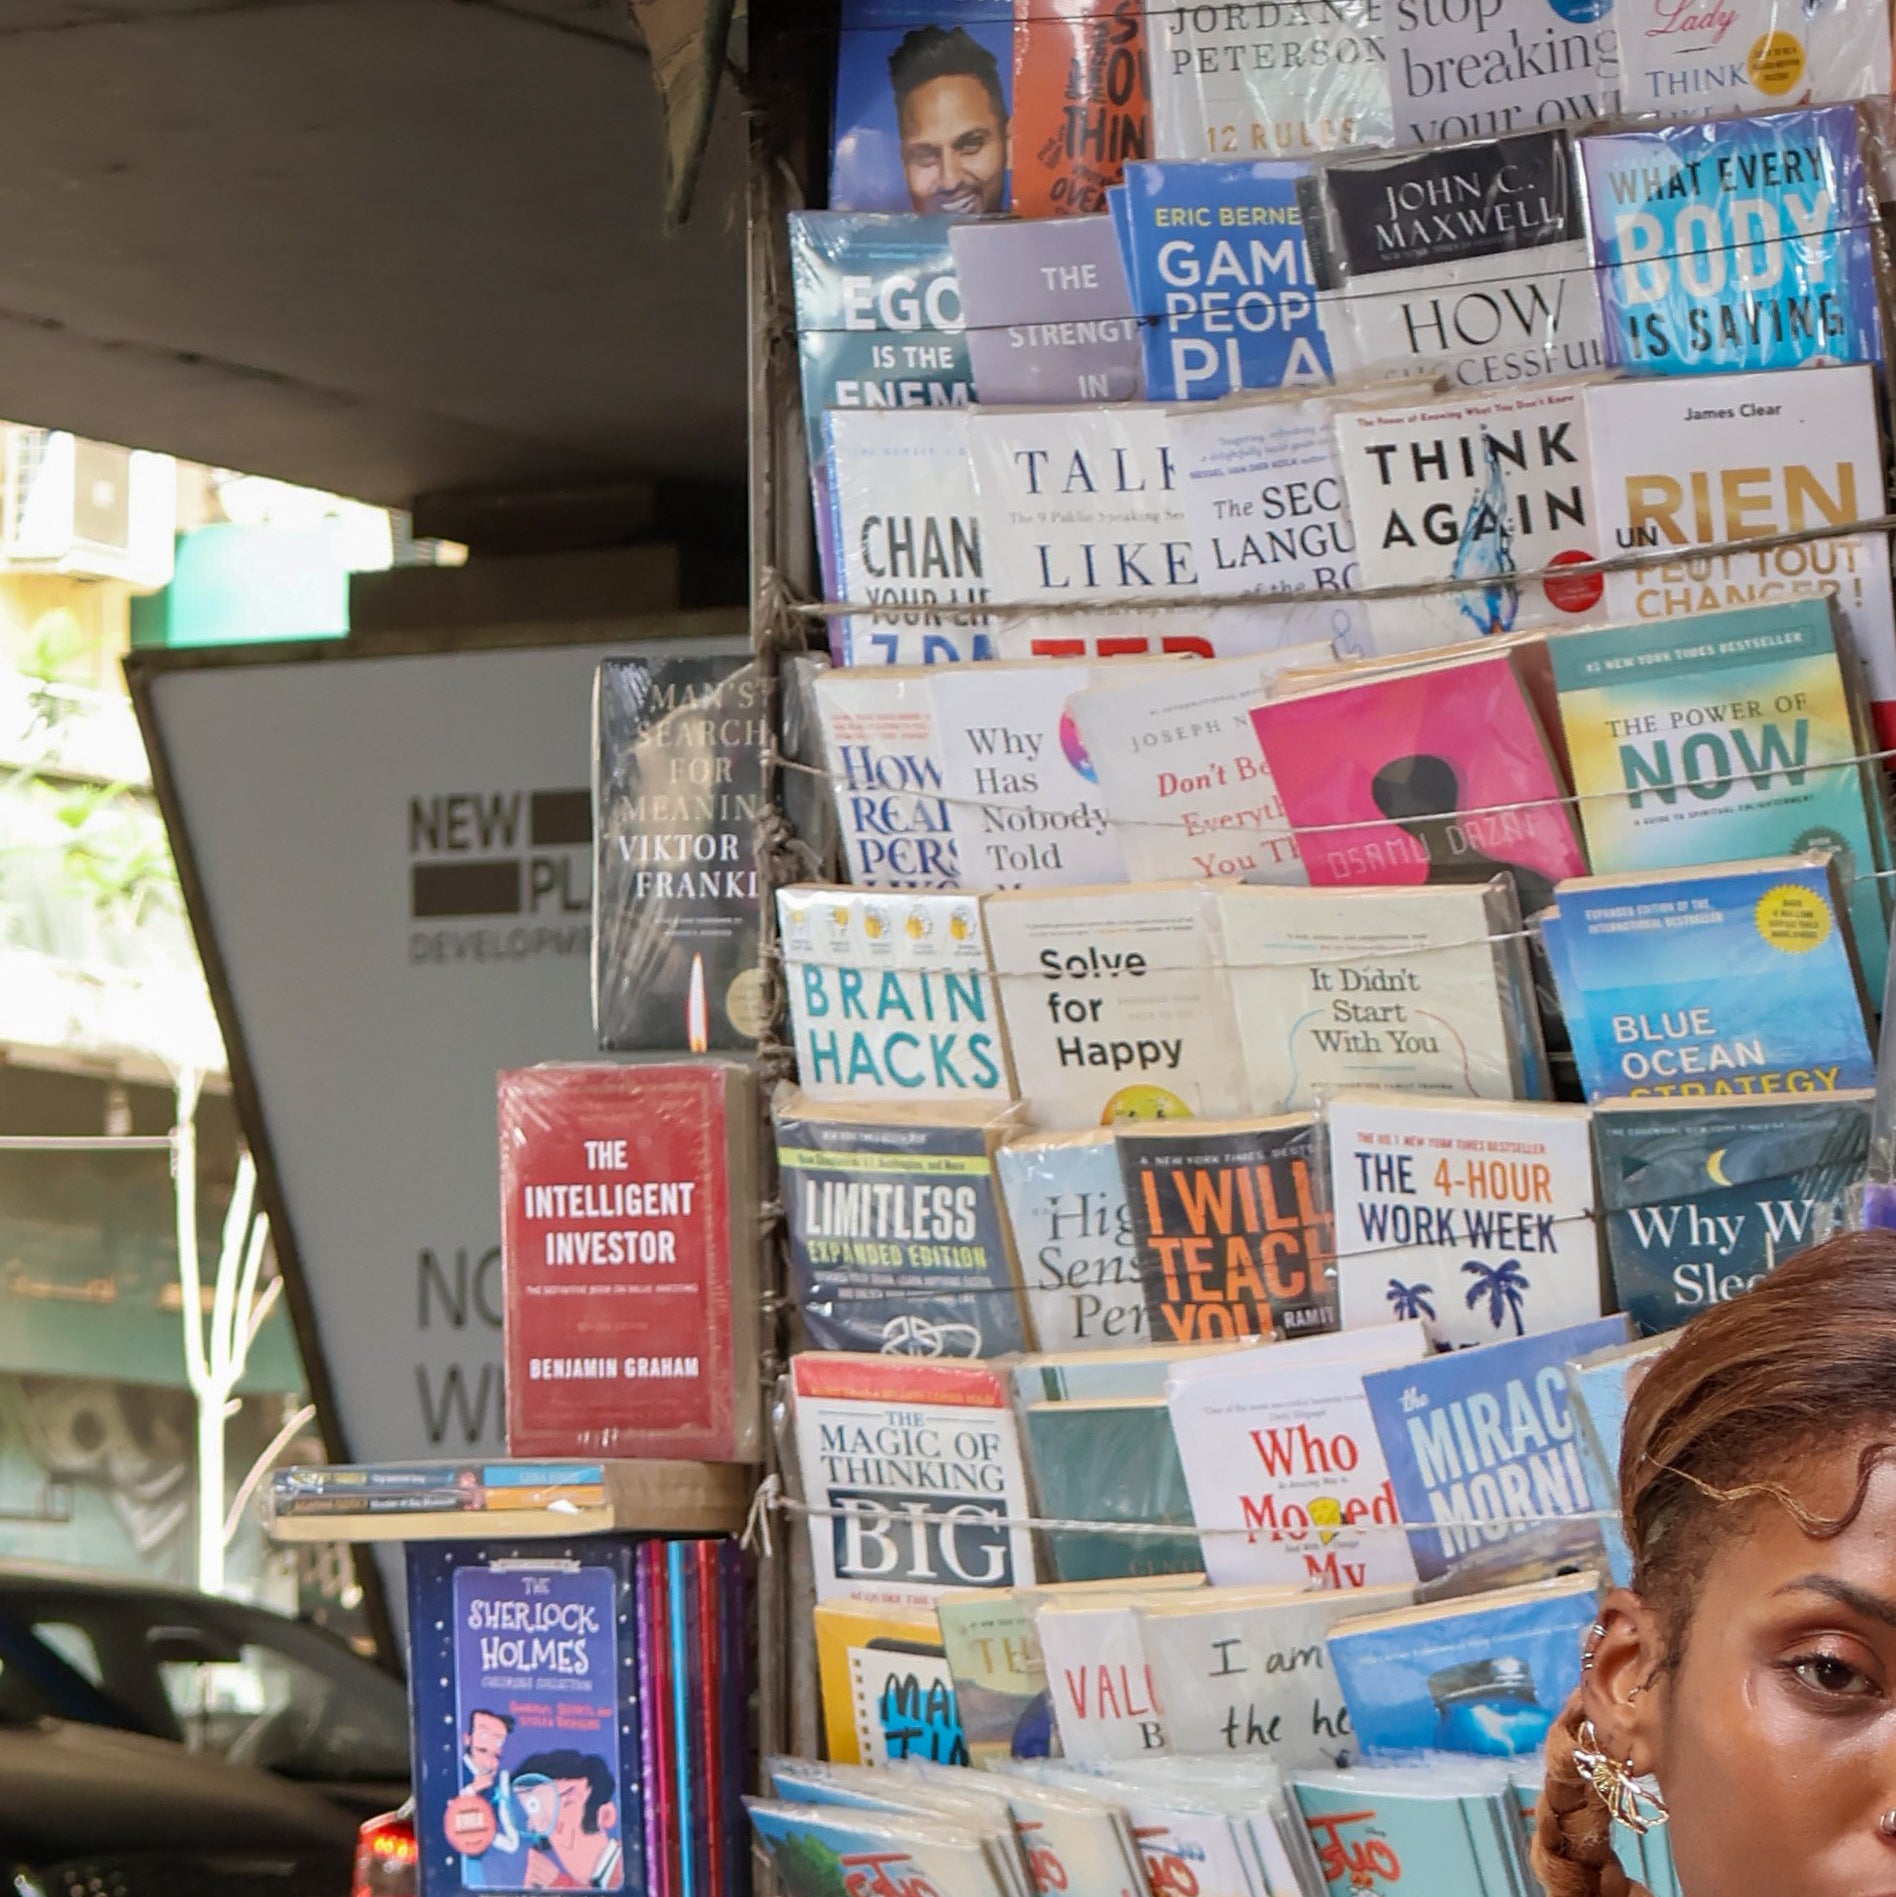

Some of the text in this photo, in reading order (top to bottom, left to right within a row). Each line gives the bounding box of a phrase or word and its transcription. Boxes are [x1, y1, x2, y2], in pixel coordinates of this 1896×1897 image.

[1171, 36, 1386, 75] PETERSON
[1403, 26, 1618, 98] breaking
[1645, 62, 1749, 98] THINK
[1206, 125, 1238, 154] 12
[1386, 165, 1536, 219] JOHN C.
[1609, 145, 1827, 206] WHAT EVERY
[1155, 206, 1302, 227] ERIC BERNE
[1374, 194, 1566, 252] MAXWELL
[1615, 189, 1835, 306] BODY
[1040, 263, 1098, 291] THE
[1401, 278, 1568, 356] HOW
[1629, 292, 1846, 359] IS SAYING
[872, 344, 954, 369] IS THE
[1079, 373, 1109, 400] IN
[1683, 402, 1782, 422] James Clear
[1364, 421, 1579, 486] THINK
[1213, 498, 1254, 520] The
[1262, 477, 1342, 520] SEC
[1382, 485, 1587, 549] AGAIN
[1625, 461, 1862, 547] RIEN
[1616, 525, 1659, 549] UN
[1037, 541, 1199, 589] LIKE
[1756, 539, 1864, 577] TOUT
[1604, 631, 1804, 671] NEW YORK TIMES BESTSELLER
[649, 680, 763, 714] MAN'S
[1605, 692, 1809, 740] THE POWER OF
[636, 718, 769, 749] SEARCH
[966, 728, 1044, 760] Why
[1130, 718, 1223, 753] JOSEPH
[668, 756, 734, 784] FOR
[975, 766, 1039, 795] Has
[1157, 762, 1228, 799] Don't
[1617, 716, 1810, 810] NOW
[410, 791, 521, 852] NEW
[982, 802, 1111, 837] Nobody
[618, 833, 740, 862] VIKTOR
[987, 842, 1063, 872] Told
[1328, 808, 1538, 881] OSAMU DAZAI
[637, 871, 761, 900] FRANKL
[1192, 855, 1254, 880] You
[1039, 946, 1148, 981] Solve
[1310, 965, 1422, 992] It Didn't
[801, 962, 988, 1022] BRAIN
[1046, 991, 1104, 1025] for
[1333, 999, 1408, 1024] Start
[1611, 1006, 1717, 1045] BLUE
[808, 1028, 1001, 1091] HACKS
[1057, 1035, 1184, 1073] Happy
[1312, 1029, 1440, 1056] With You
[1621, 1039, 1767, 1081] OCEAN
[584, 1139, 630, 1171] THE
[1354, 1152, 1554, 1204] THE 4-HOUR
[524, 1181, 696, 1221] INTELLIGENT
[806, 1180, 978, 1243] LIMITLESS
[1140, 1158, 1336, 1237] I WILL
[1359, 1202, 1560, 1255] WORK WEEK
[1629, 1203, 1746, 1256] Why
[544, 1230, 677, 1267] INVESTOR
[806, 1239, 989, 1270] EXPANDED EDITION
[1147, 1221, 1338, 1302] TEACH
[1161, 1301, 1277, 1345] YOU
[1283, 1306, 1336, 1331] RAMIT
[529, 1355, 700, 1380] BENJAMIN GRAHAM
[1398, 1386, 1430, 1413] the
[885, 1410, 925, 1429] THE
[820, 1423, 1001, 1461] MAGIC OF
[1248, 1423, 1359, 1478] Who
[820, 1455, 1006, 1493] THINKING
[834, 1498, 1009, 1584] BIG
[521, 1575, 551, 1595] THE
[468, 1598, 600, 1634] SHERLOCK
[481, 1637, 590, 1676] HOLMES
[1208, 1638, 1325, 1678] I am
[1220, 1704, 1284, 1750] the
